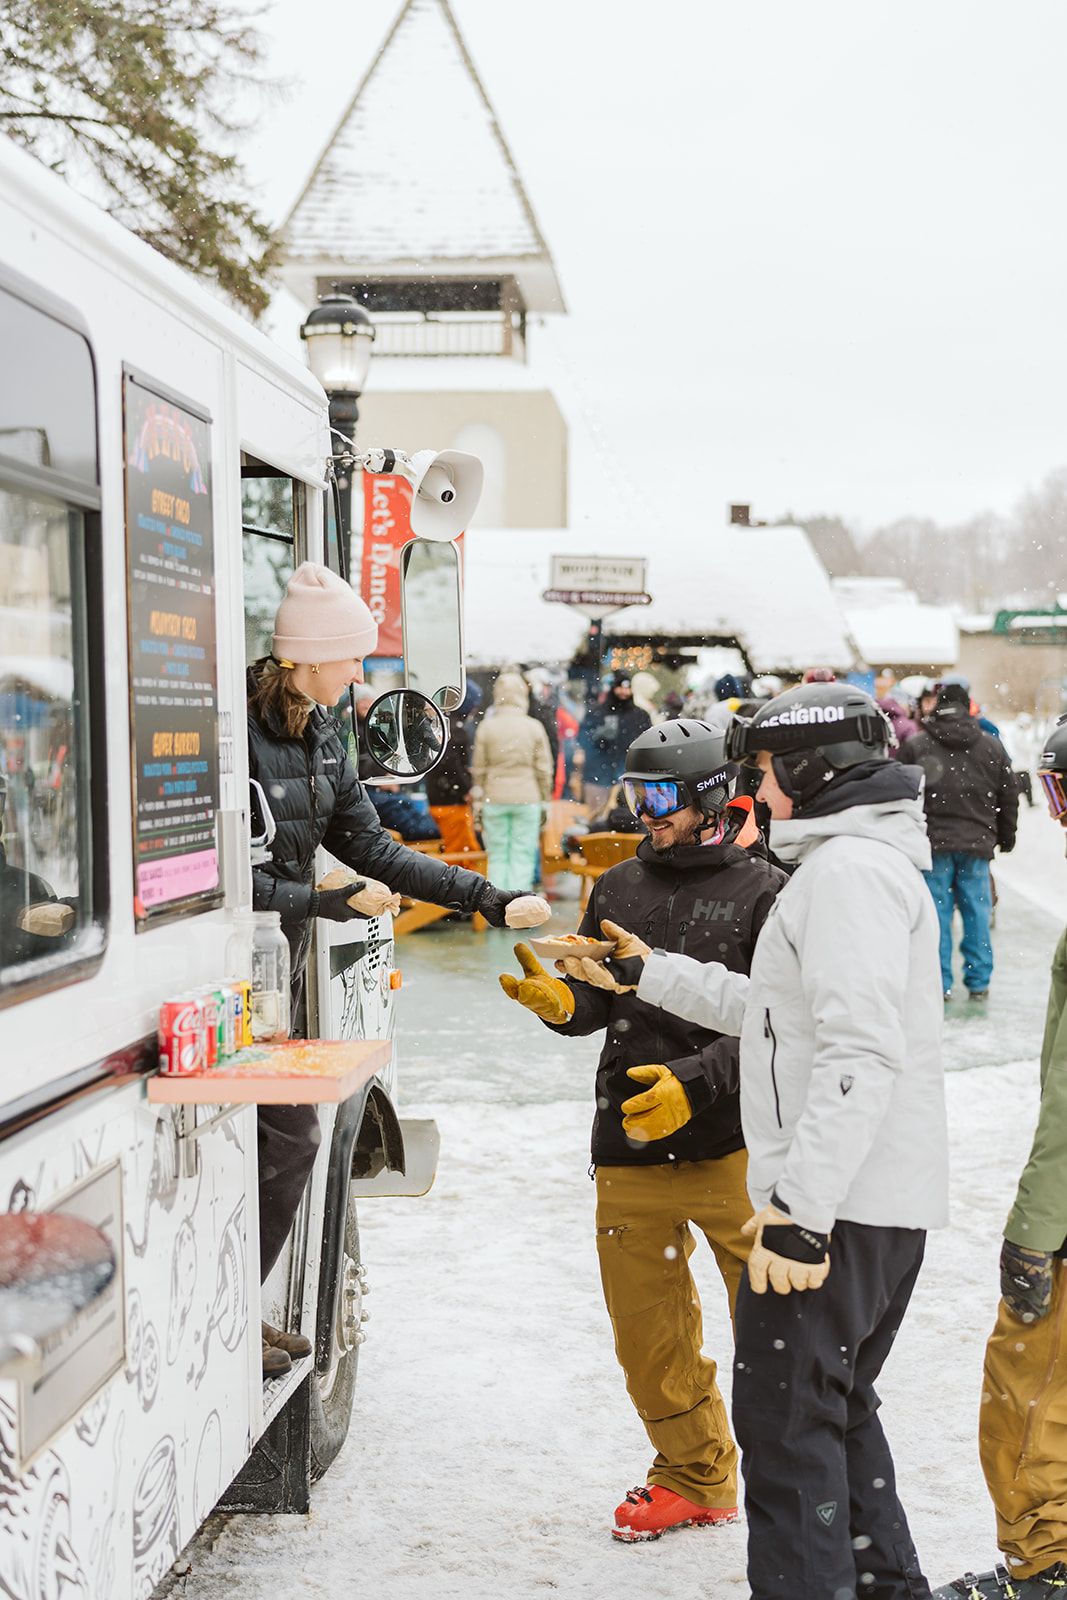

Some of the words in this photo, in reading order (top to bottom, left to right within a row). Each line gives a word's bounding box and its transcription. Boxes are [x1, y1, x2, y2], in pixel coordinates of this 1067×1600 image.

[372, 479, 396, 537] Let's
[370, 543, 394, 625] Dance
[696, 771, 727, 792] SMITH
[692, 898, 735, 921] HH
